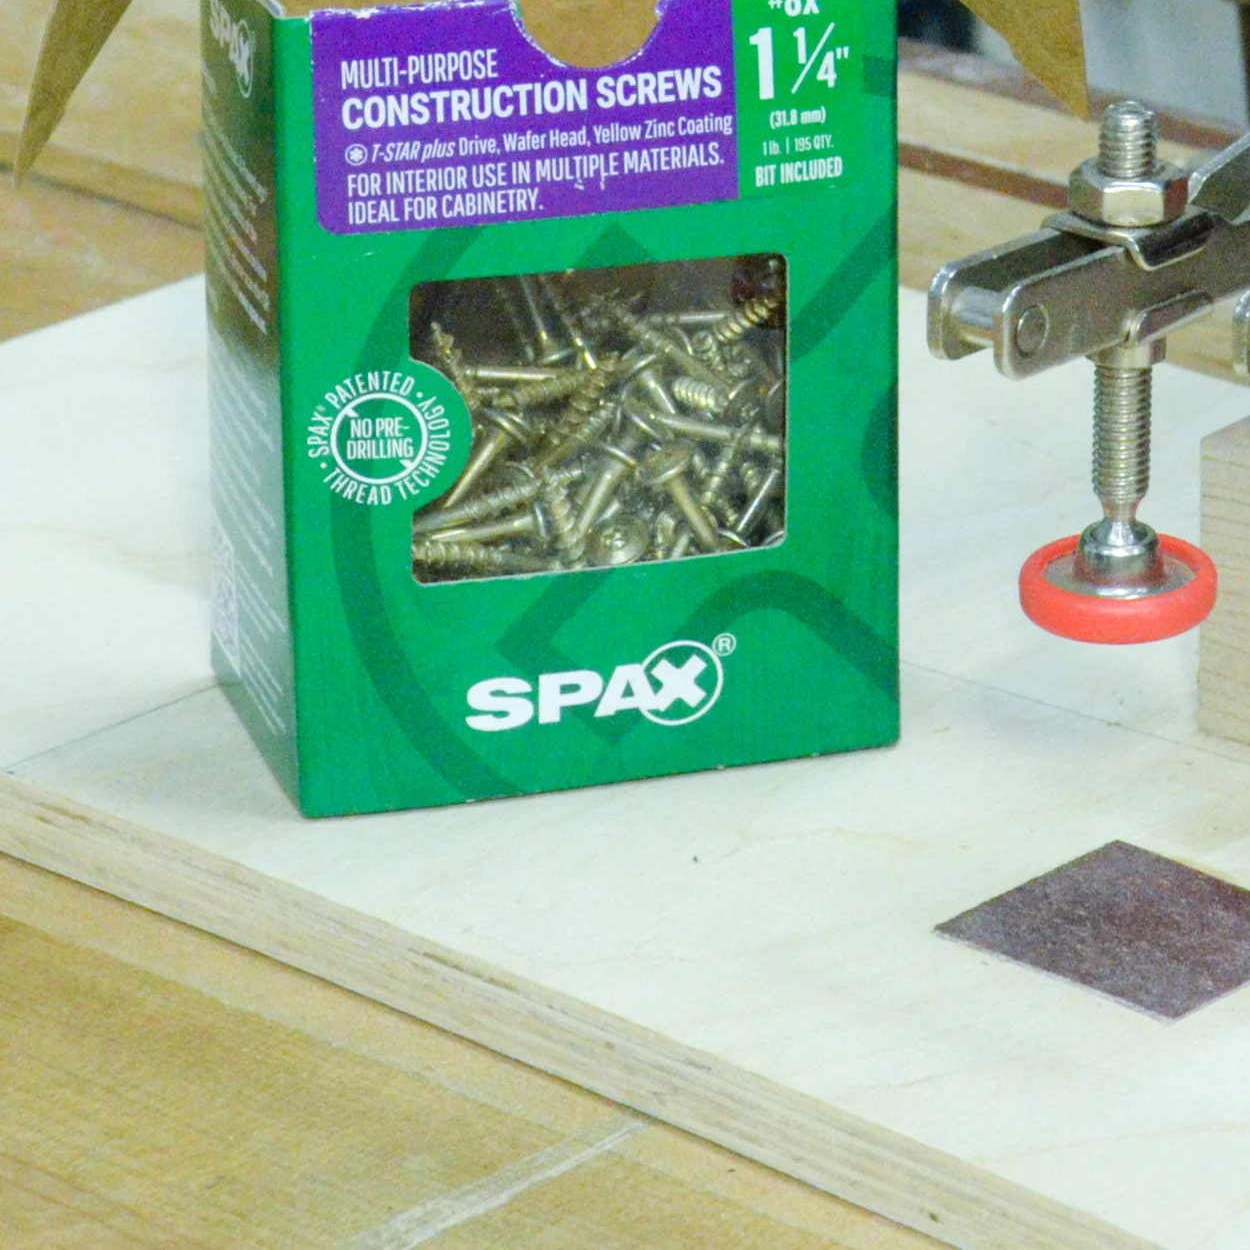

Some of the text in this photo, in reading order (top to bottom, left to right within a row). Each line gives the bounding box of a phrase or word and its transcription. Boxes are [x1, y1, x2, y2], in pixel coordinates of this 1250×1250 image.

[341, 49, 498, 90] MULTI-PURPOSE
[342, 66, 722, 130] CONSTRUCTION SCREWS
[769, 106, 827, 130] (31.8 mm)
[371, 113, 733, 163] T-STAR plus Drive, Wafer Head, Yellow Zinc Coating
[794, 136, 811, 152] 195
[813, 134, 834, 150] QTY.
[347, 141, 725, 197] FOR INTERIOR USE IN MULTIPLE MATERIALS.
[755, 155, 844, 188] BIT INCLUDED
[348, 187, 544, 225] IDEAL FOR CABINETRY.
[324, 370, 415, 410] PATENTED
[350, 417, 410, 439] NO PRE-
[322, 396, 451, 506] THREAD TECHNOLOGY
[346, 437, 414, 461] DRILLING
